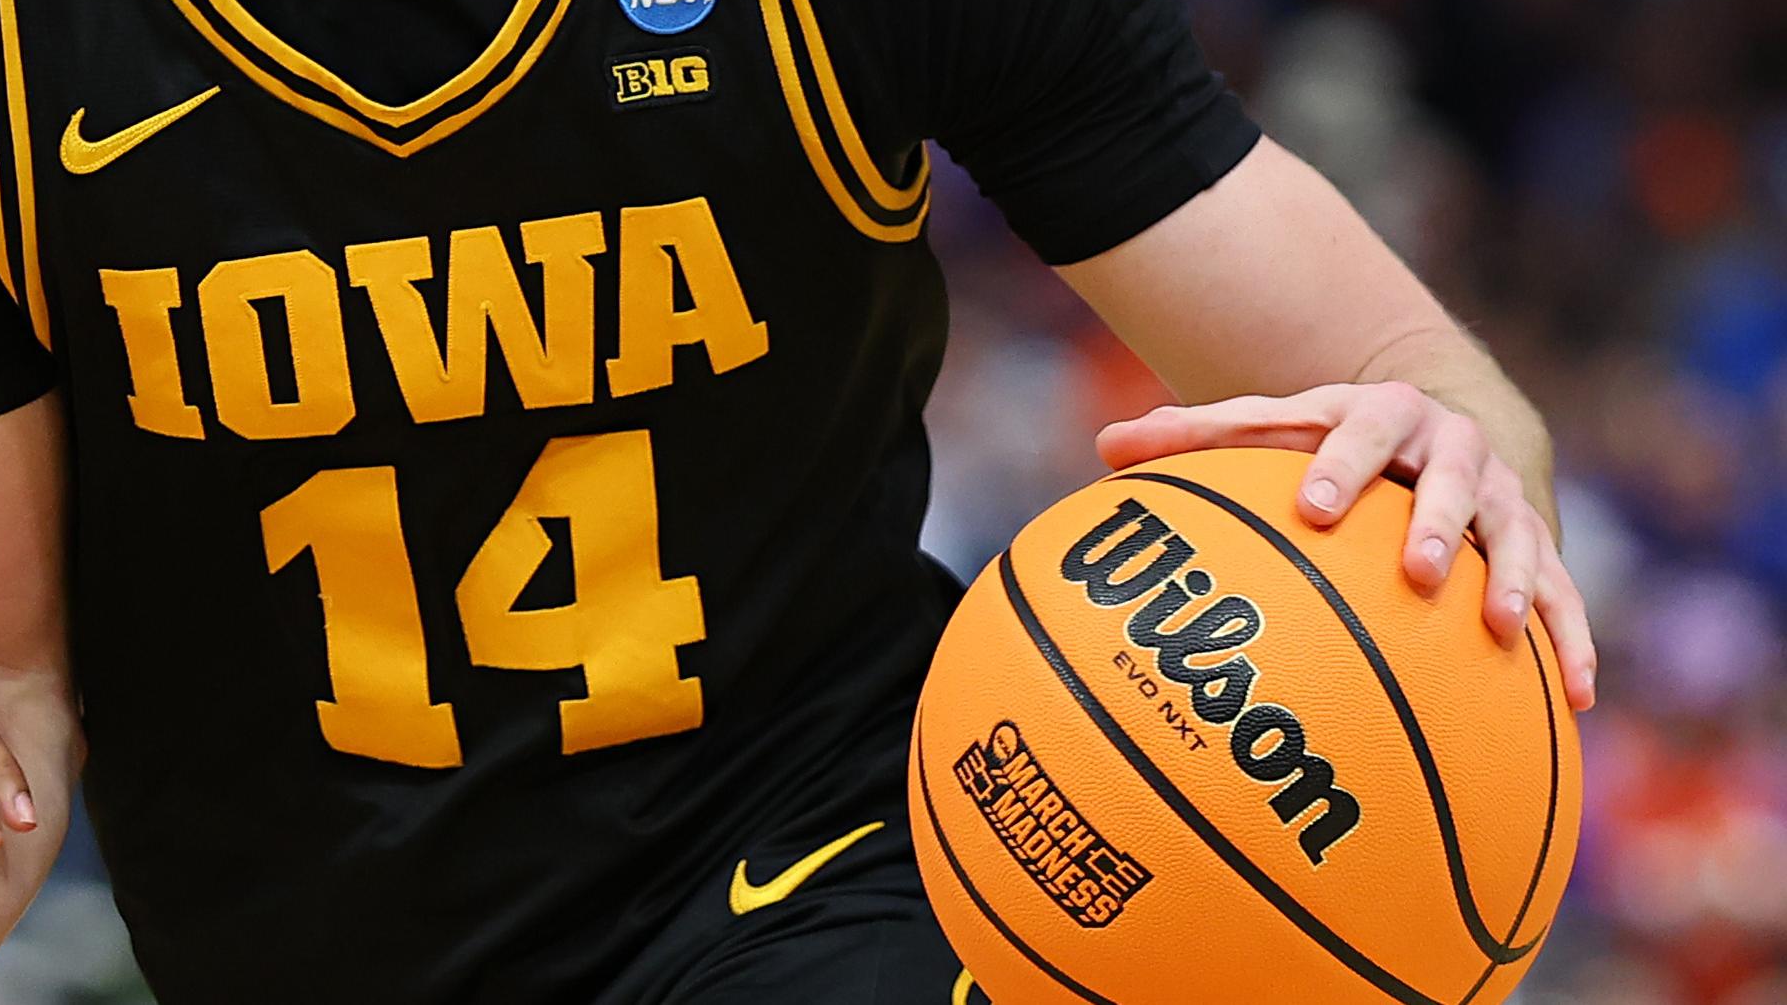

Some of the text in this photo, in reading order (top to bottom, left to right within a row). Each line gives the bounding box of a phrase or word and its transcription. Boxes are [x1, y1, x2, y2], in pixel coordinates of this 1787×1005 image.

[98, 196, 769, 440] IOWA
[259, 428, 707, 769] 14
[1059, 497, 1363, 871] Wilson
[1112, 650, 1209, 752] EVO NXT
[991, 788, 1119, 924] MADNESS
[1002, 751, 1096, 858] MARCH
